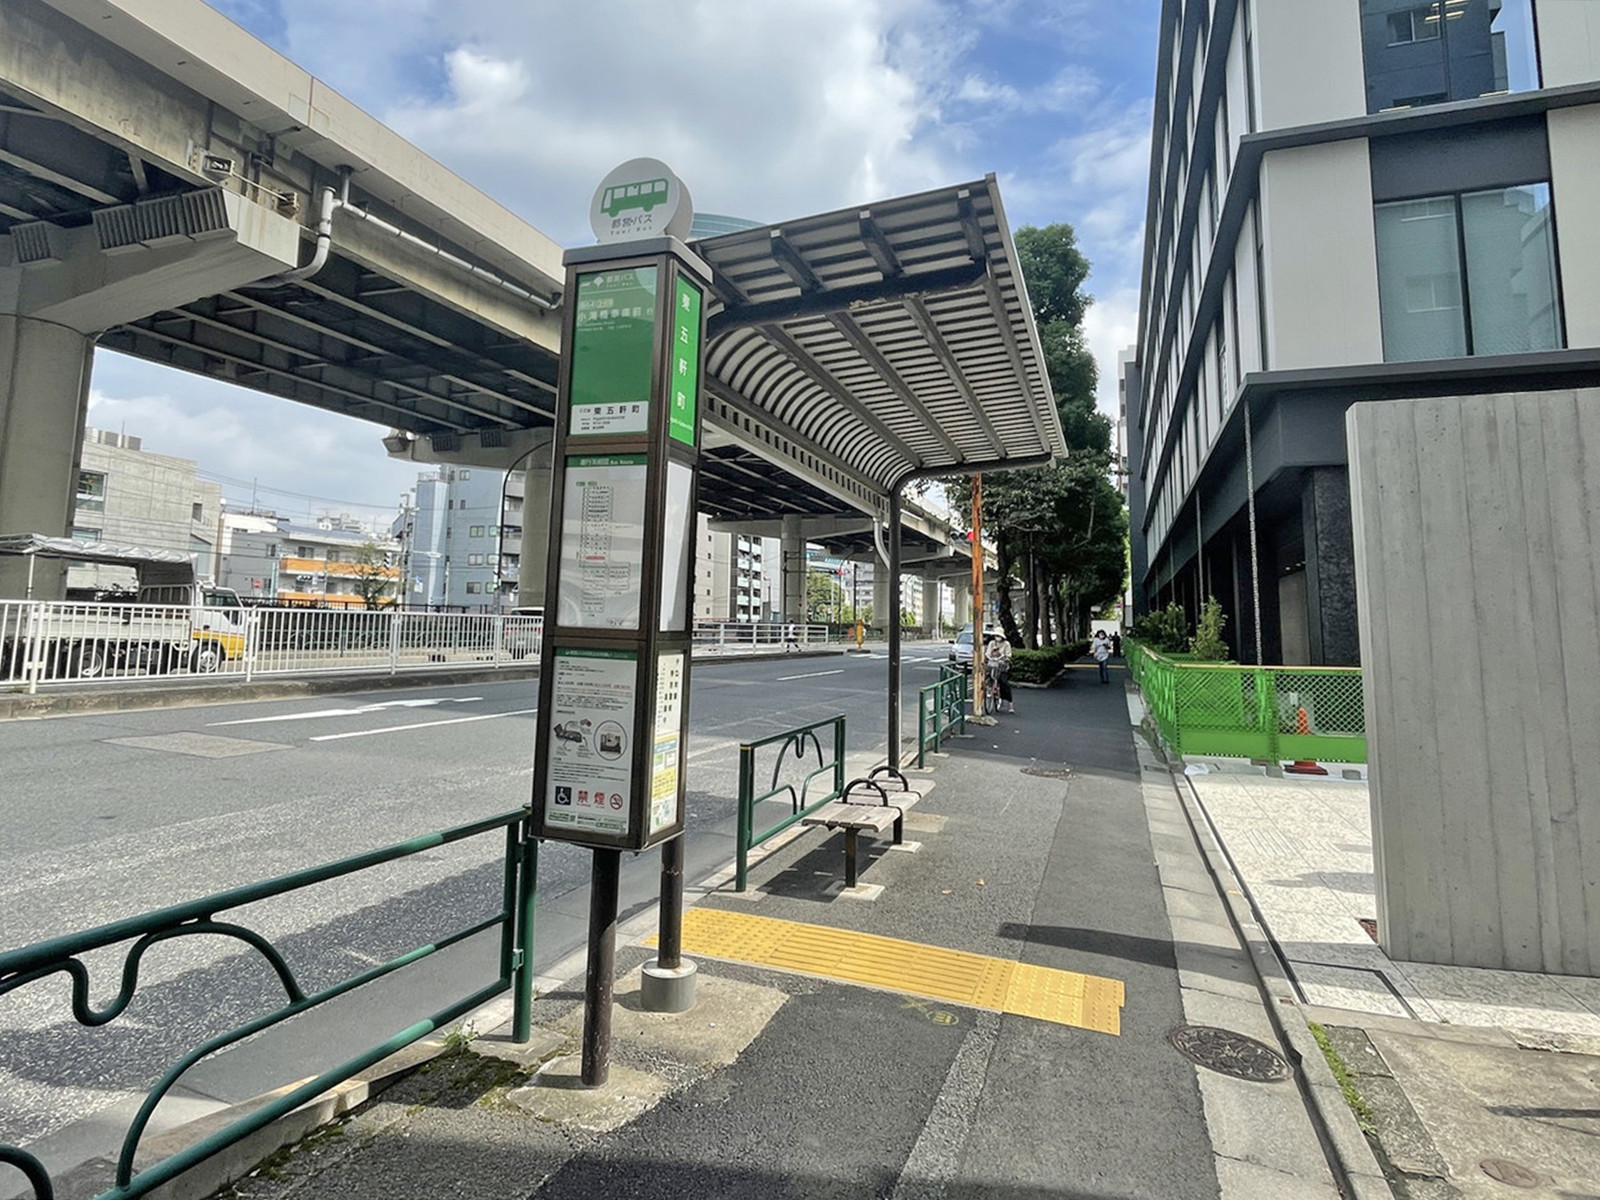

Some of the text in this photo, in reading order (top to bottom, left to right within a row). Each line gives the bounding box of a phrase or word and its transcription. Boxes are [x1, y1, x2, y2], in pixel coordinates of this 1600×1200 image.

[611, 214, 652, 229] 都営バス
[677, 293, 691, 410] 東五軒町
[593, 404, 640, 415] 東五軒町
